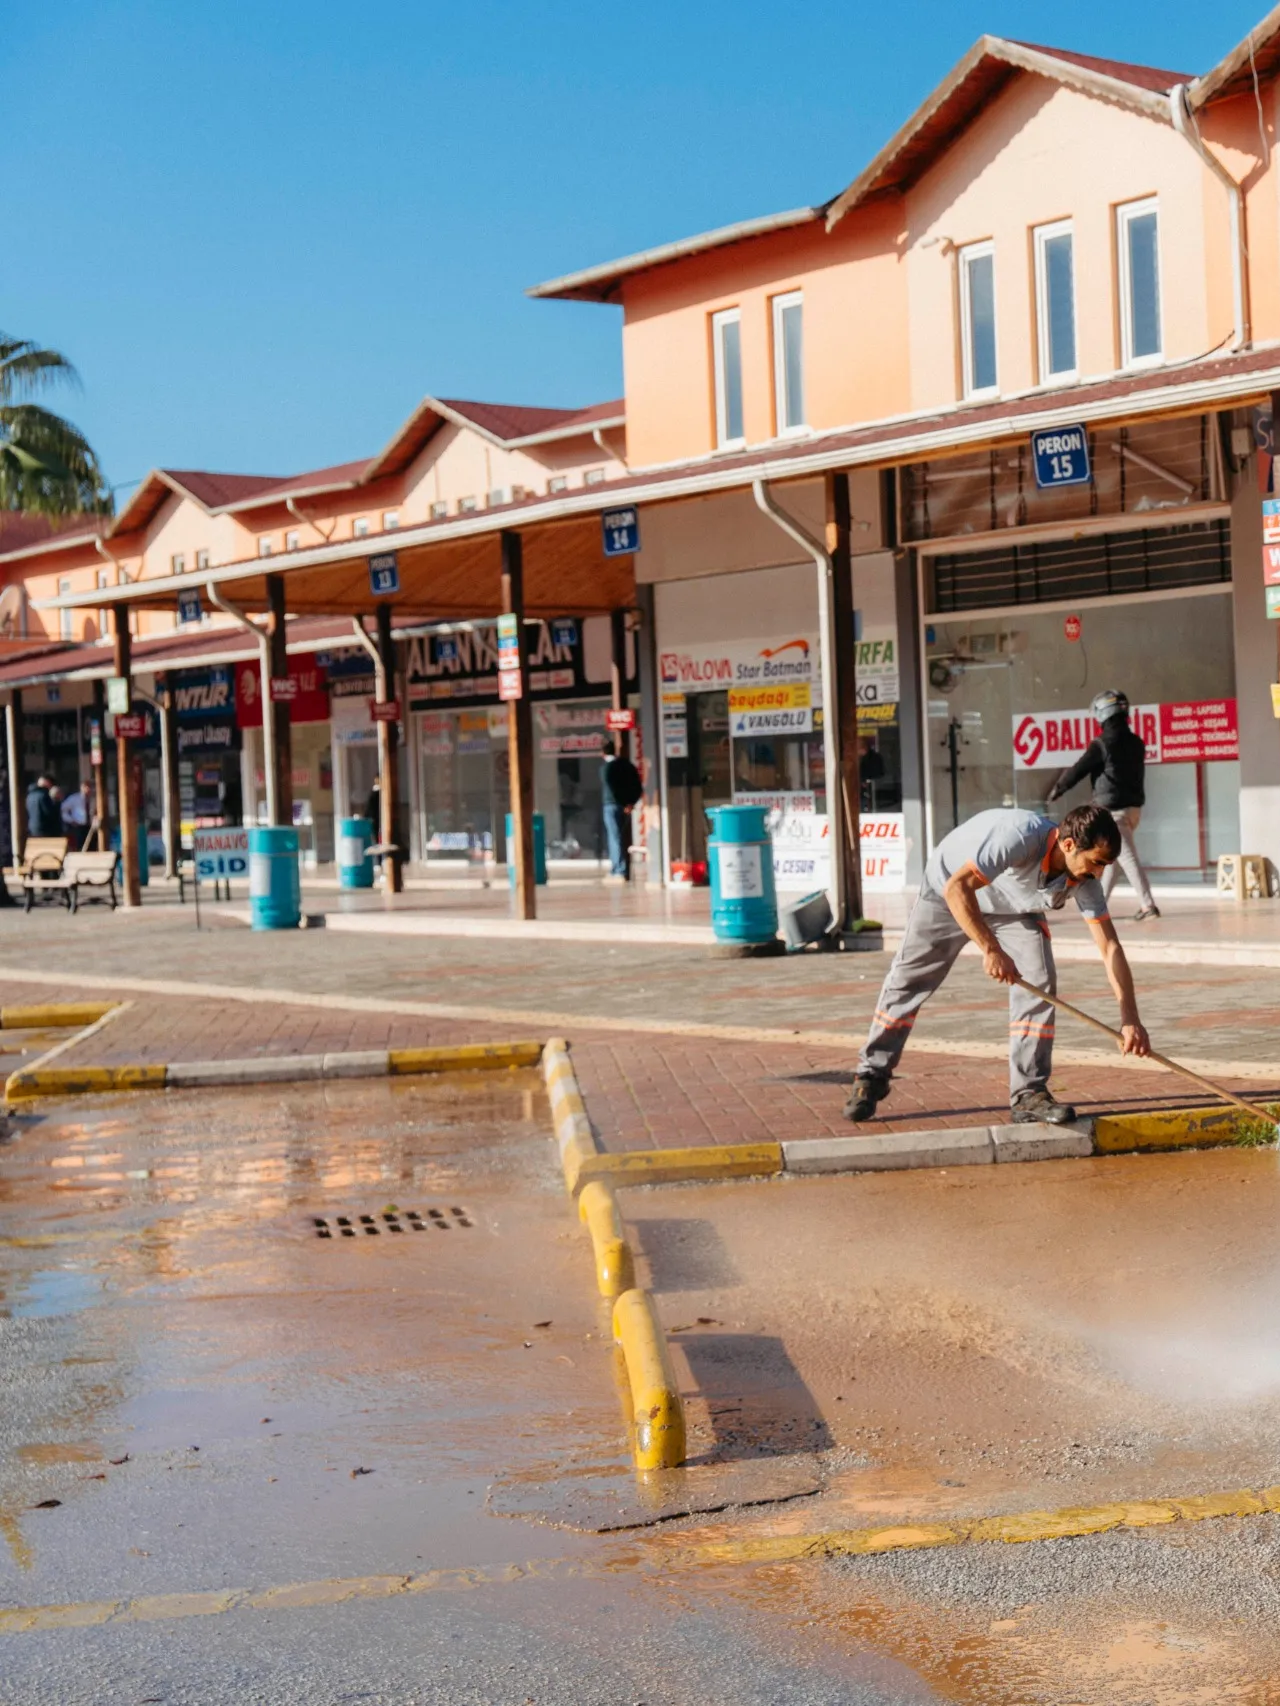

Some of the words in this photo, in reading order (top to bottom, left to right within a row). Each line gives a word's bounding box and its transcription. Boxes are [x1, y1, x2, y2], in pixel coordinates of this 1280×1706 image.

[1037, 432, 1081, 456] PERON
[1050, 454, 1073, 479] 15
[612, 528, 630, 550] 14
[736, 663, 761, 680] Star
[763, 660, 812, 678] Batman
[609, 710, 632, 722] WC
